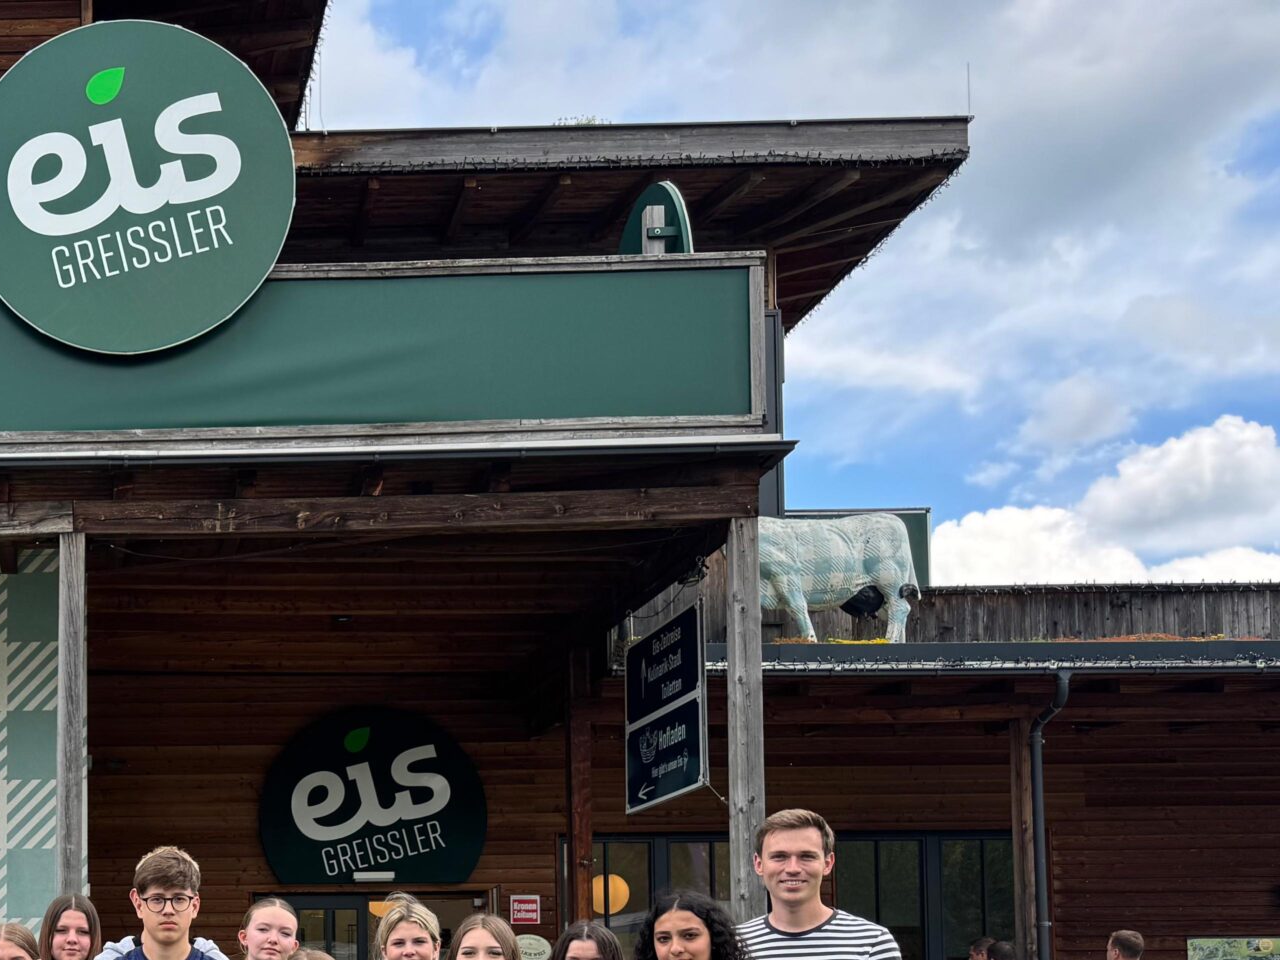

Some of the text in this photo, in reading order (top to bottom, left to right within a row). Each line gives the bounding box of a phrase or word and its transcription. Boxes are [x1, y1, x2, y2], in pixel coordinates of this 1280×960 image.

[7, 67, 242, 236] eis
[51, 205, 234, 289] GREISSLER
[661, 679, 682, 700] Toiletten
[658, 722, 686, 750] Hofladen
[291, 727, 451, 841] eis
[321, 820, 446, 876] GREISSLER
[513, 902, 537, 910] Kronen
[513, 911, 537, 919] Zeitung
